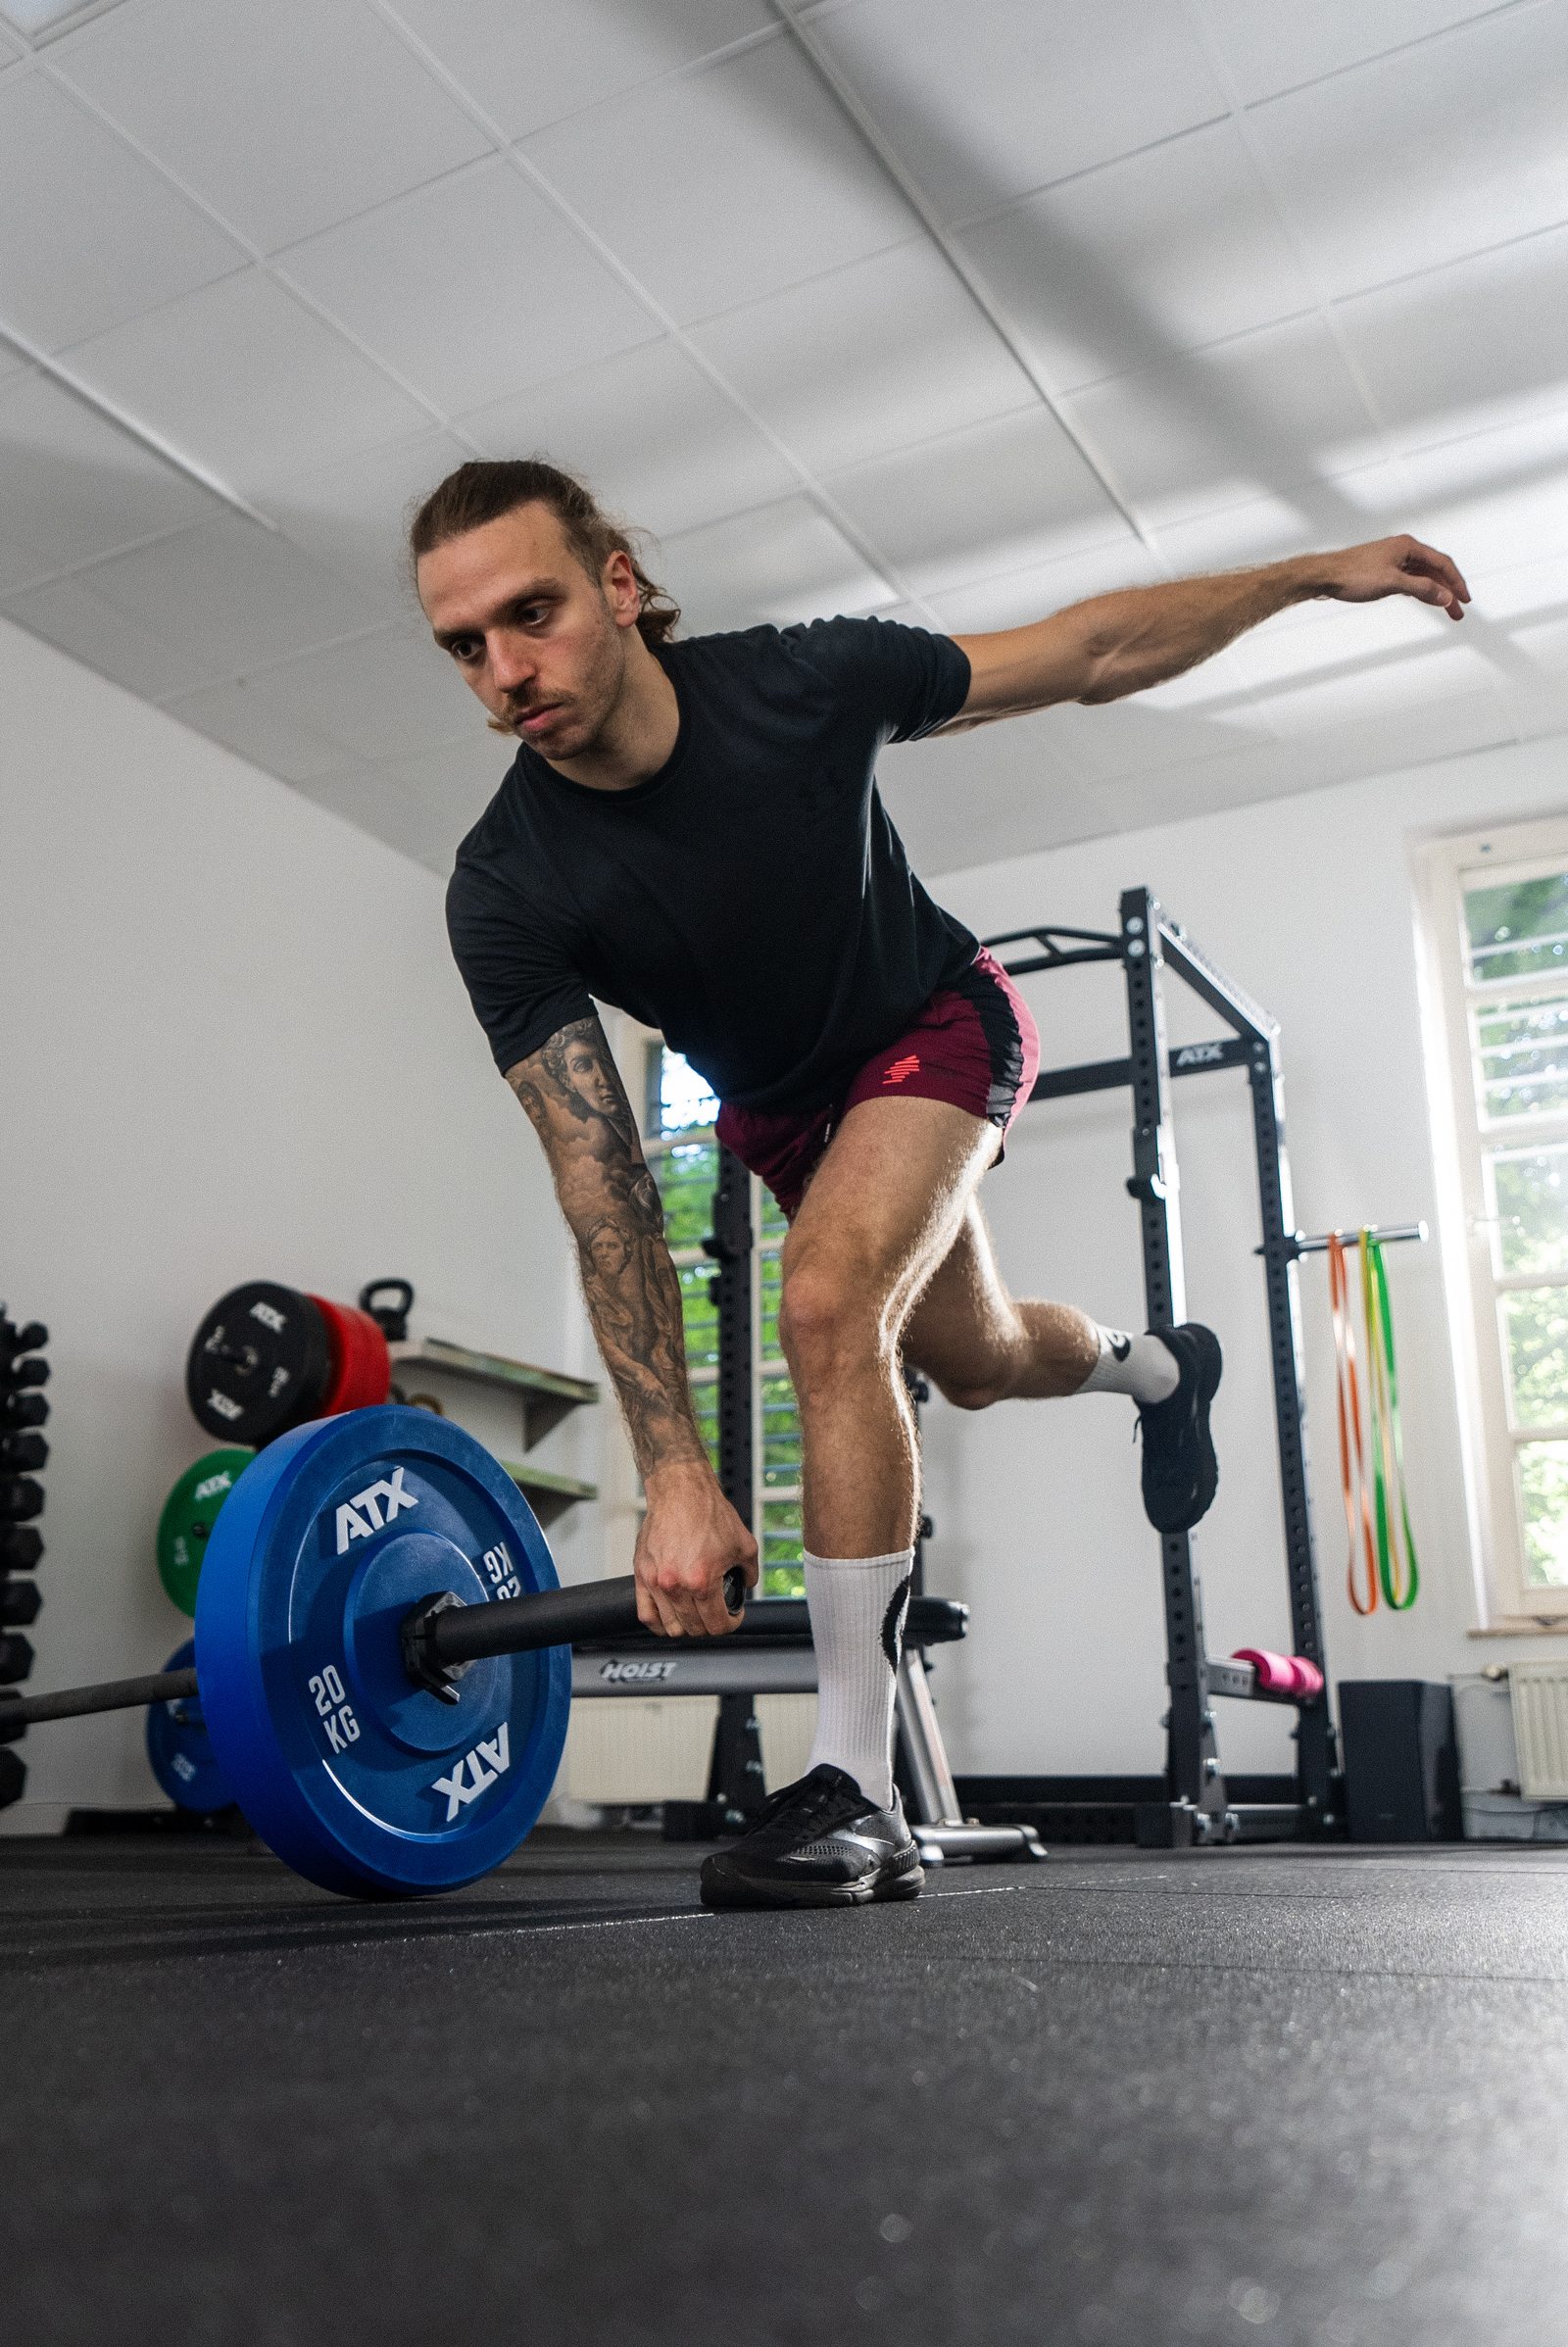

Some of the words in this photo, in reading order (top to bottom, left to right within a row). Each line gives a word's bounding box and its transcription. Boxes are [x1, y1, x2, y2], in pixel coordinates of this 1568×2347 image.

[1176, 1043, 1223, 1066] ATX
[336, 1467, 418, 1555] ATX
[483, 1541, 513, 1584] KG
[309, 1665, 345, 1716] 20
[601, 1661, 676, 1679] HOIST
[323, 1706, 361, 1754] KG
[432, 1722, 511, 1822] ATX
